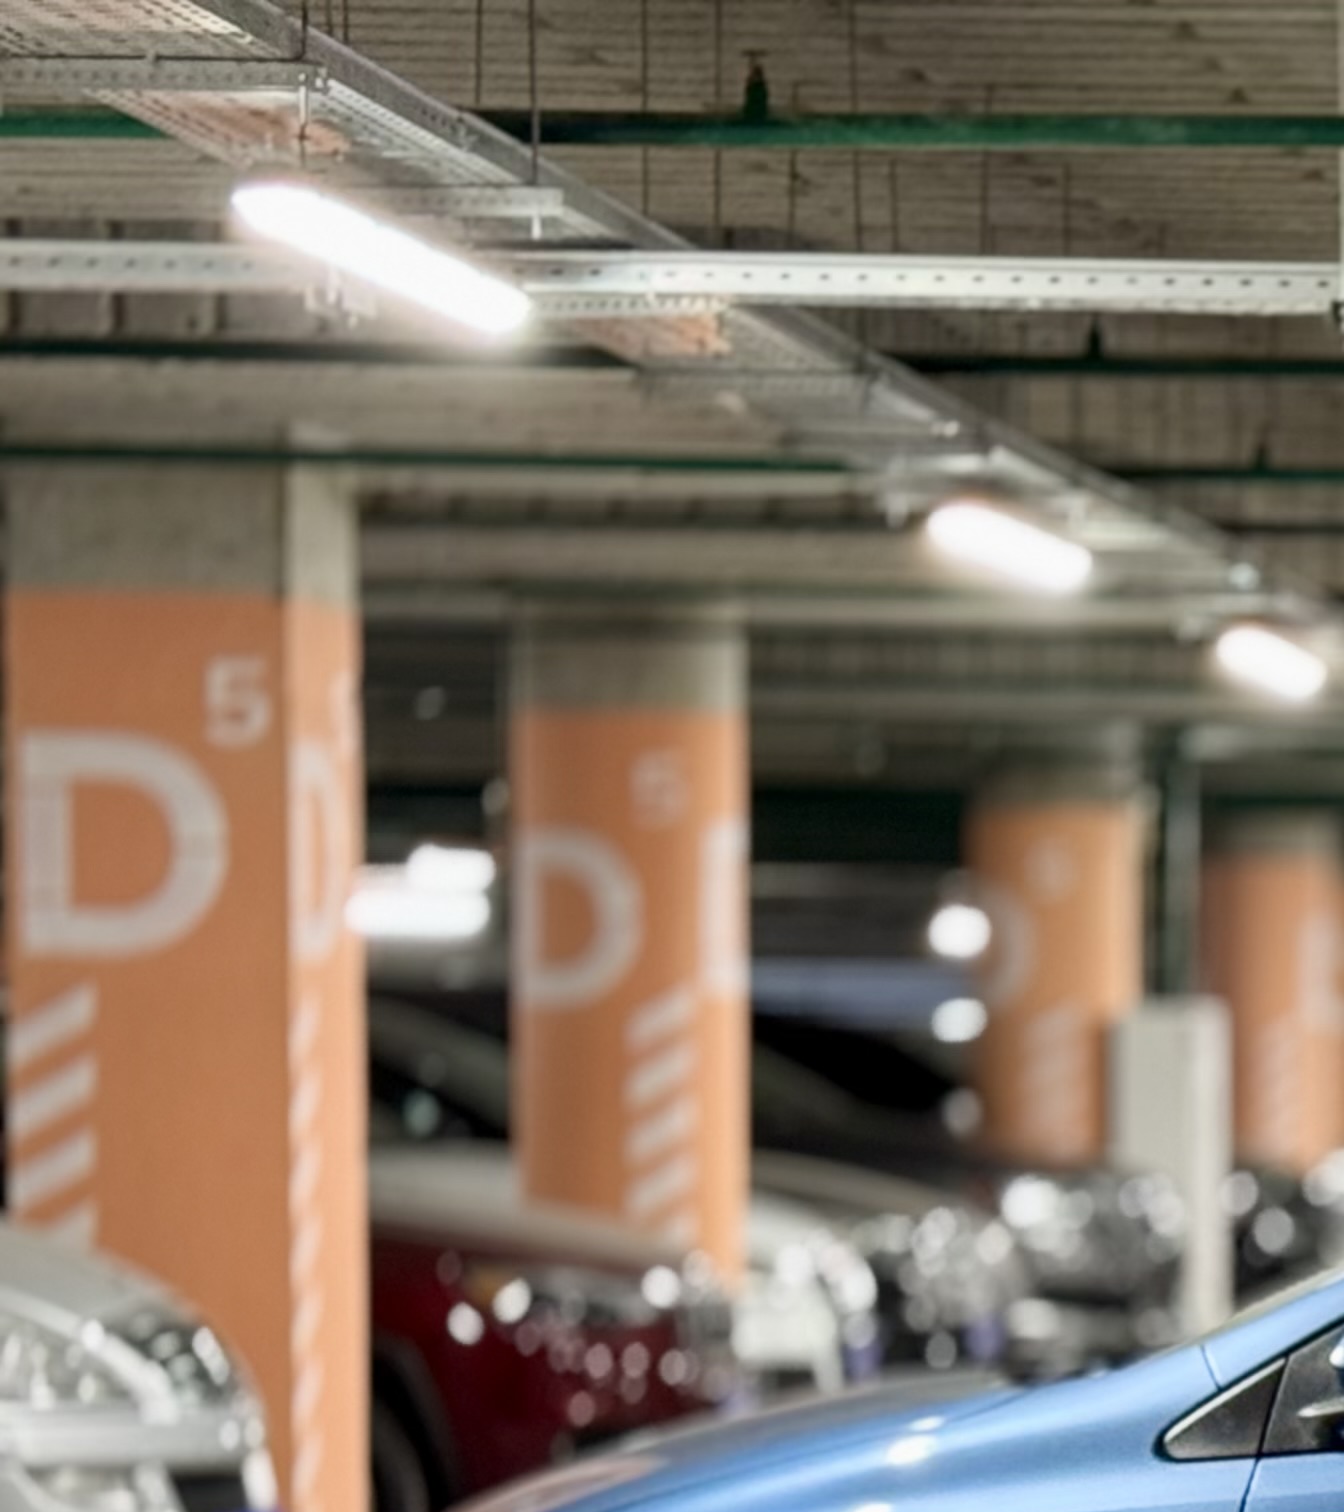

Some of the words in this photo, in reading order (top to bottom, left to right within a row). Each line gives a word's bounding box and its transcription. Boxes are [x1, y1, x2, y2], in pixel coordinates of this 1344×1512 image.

[204, 656, 271, 748] 5
[18, 730, 230, 960] D
[515, 826, 644, 1012] D
